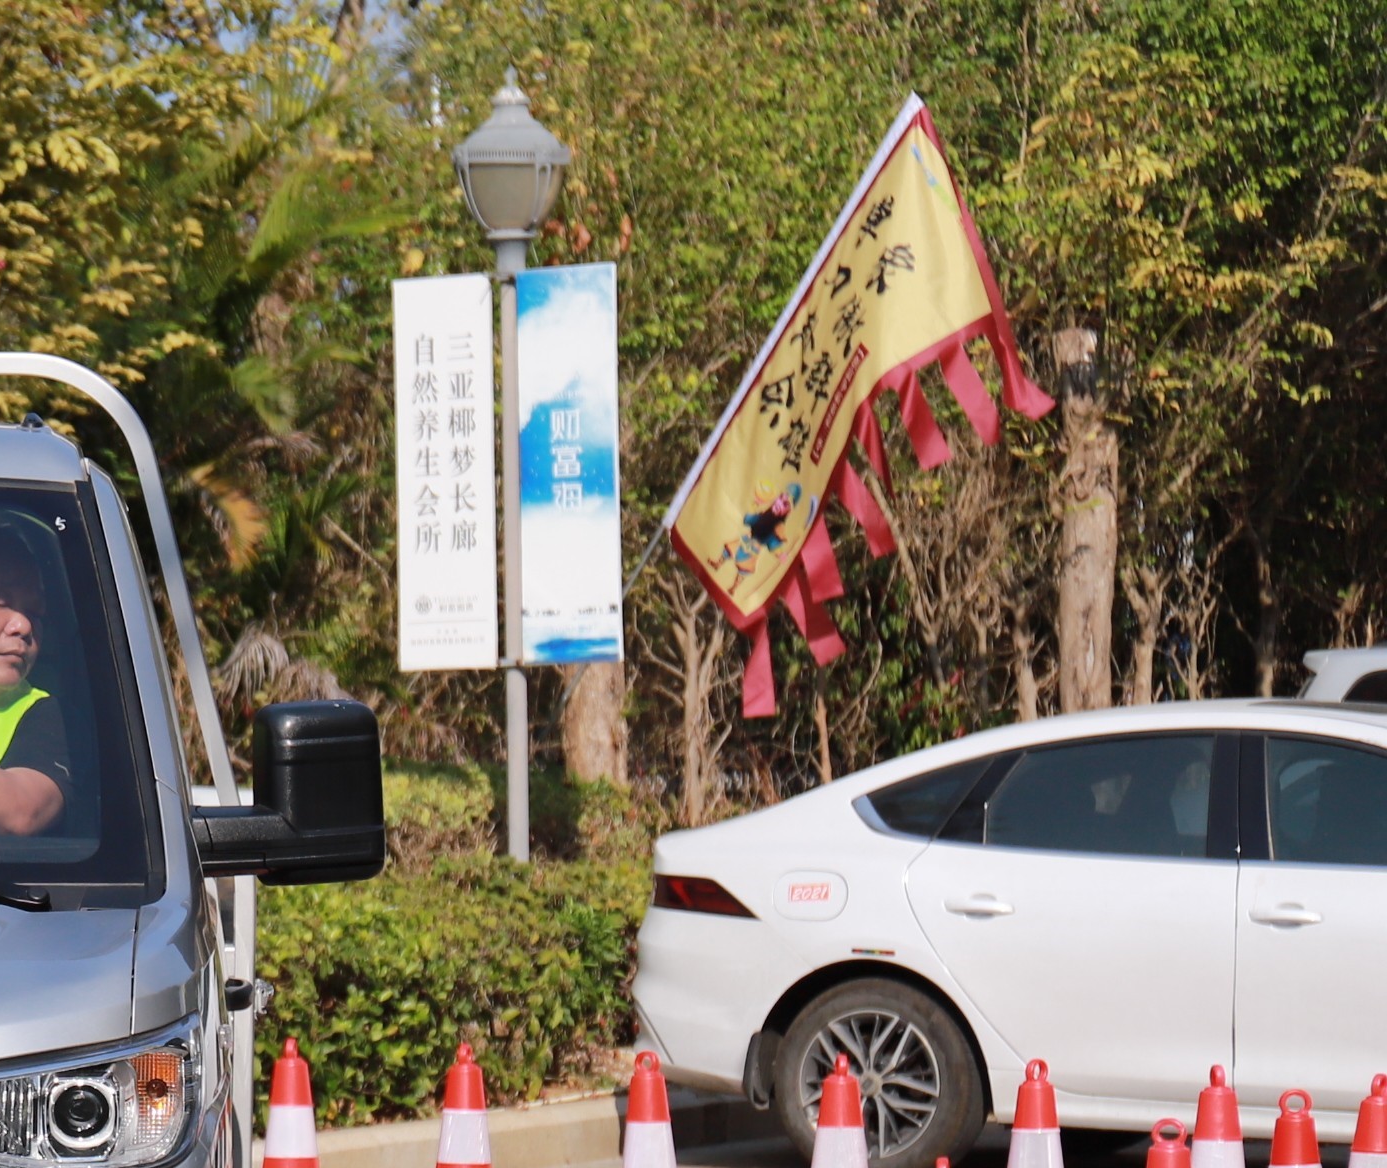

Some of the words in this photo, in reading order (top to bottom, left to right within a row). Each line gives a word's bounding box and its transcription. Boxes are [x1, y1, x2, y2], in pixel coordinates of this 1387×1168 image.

[411, 332, 442, 554] 自然养生会所
[447, 331, 477, 553] 三亚椰梦长廊
[792, 885, 828, 901] 2021
